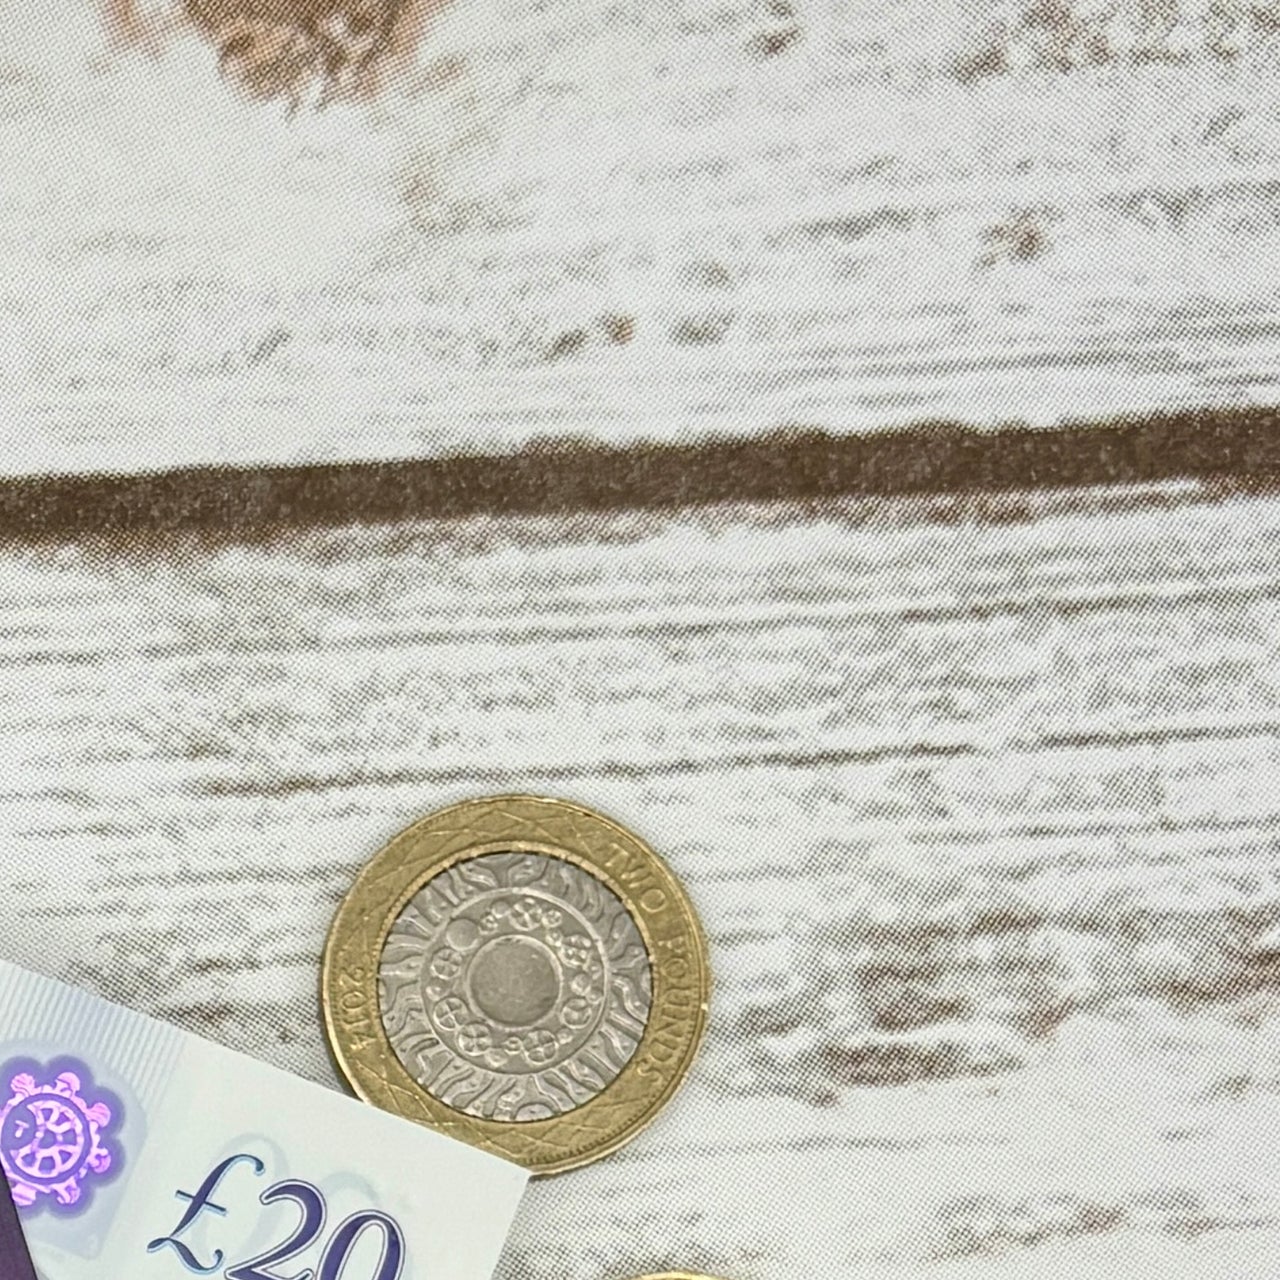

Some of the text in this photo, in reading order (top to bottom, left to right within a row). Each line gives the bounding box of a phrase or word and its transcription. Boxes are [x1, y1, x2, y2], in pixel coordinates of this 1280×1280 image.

[338, 965, 379, 1050] 2014
[604, 842, 692, 1086] TWO POUNDS
